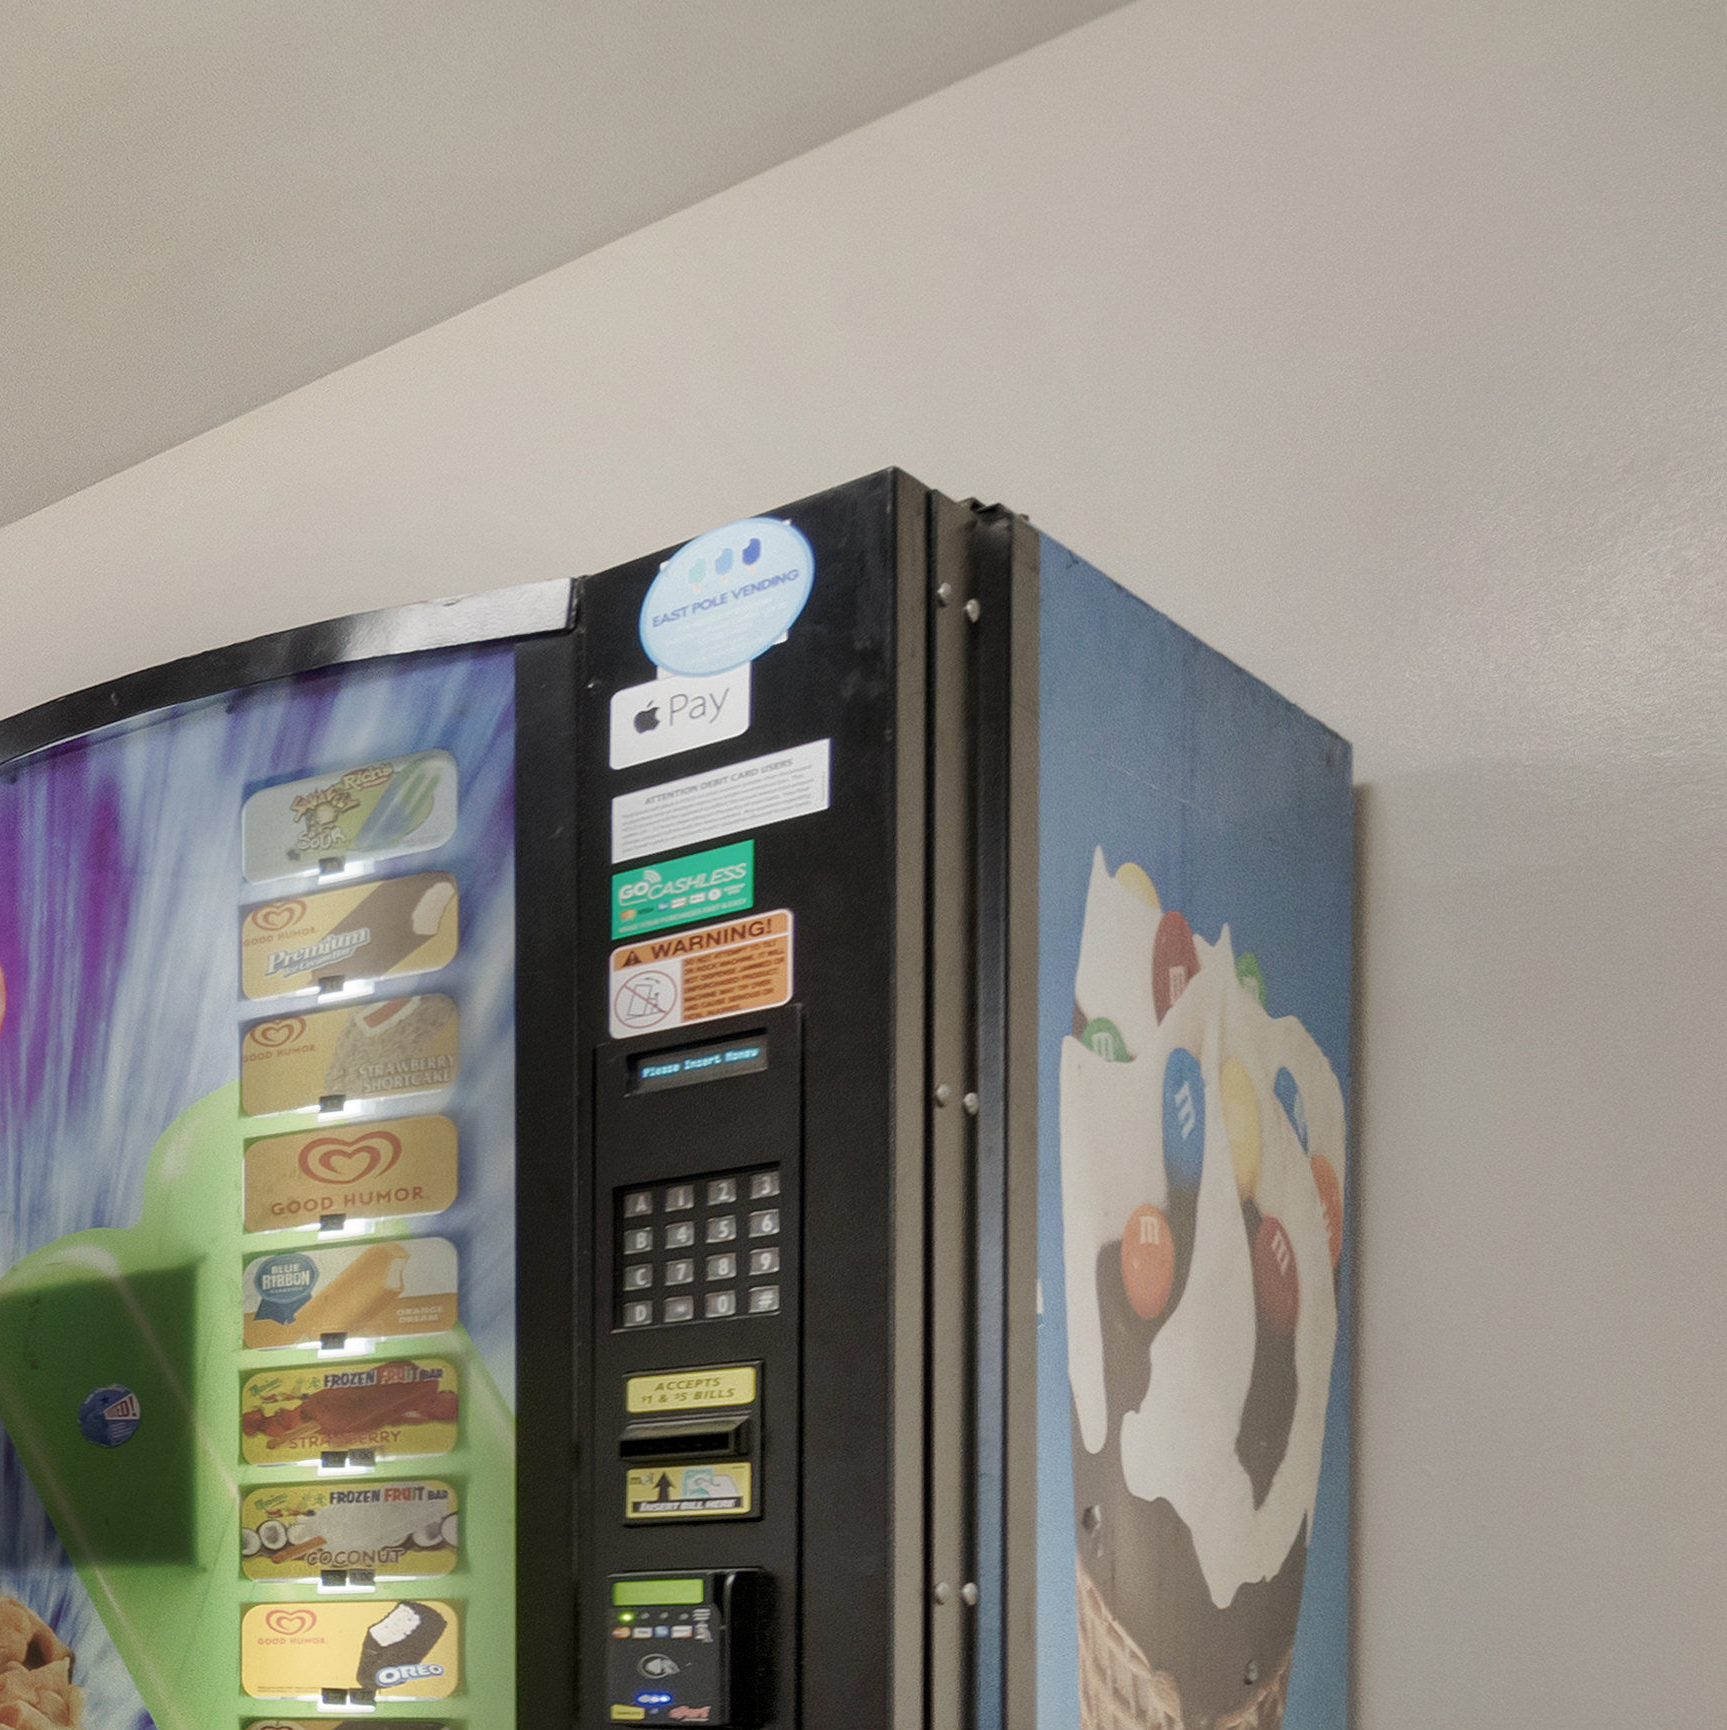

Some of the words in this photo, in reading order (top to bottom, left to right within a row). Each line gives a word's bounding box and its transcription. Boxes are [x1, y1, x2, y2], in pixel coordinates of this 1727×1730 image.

[652, 606, 689, 628] EAST
[692, 592, 729, 616] POLE
[731, 569, 800, 600] VENDING
[668, 688, 730, 726] Pay
[645, 785, 699, 805] ATTENTION
[700, 776, 729, 791] DEBIT
[731, 768, 759, 783] CARD
[761, 758, 794, 774] USERS
[648, 862, 748, 900] CASHLESS
[243, 935, 274, 948] GOOD
[651, 918, 773, 960] WARNING!
[265, 928, 370, 977] Premium
[277, 1045, 316, 1058] HUMOR
[359, 1055, 455, 1078] STRAWBERRY
[642, 1062, 681, 1079] Please
[683, 1054, 722, 1071] Insert
[363, 1068, 451, 1093] SHORTCAKE
[718, 1182, 729, 1200] 2
[760, 1177, 771, 1195] 3
[271, 1197, 334, 1216] GOOD
[343, 1186, 424, 1207] HUMOR
[636, 1194, 646, 1212] A
[677, 1187, 685, 1206] 1
[719, 1220, 729, 1238] 5
[761, 1215, 772, 1232] 6
[636, 1232, 646, 1249] B
[676, 1226, 687, 1243] 4
[271, 1263, 301, 1274] BLUE
[718, 1258, 729, 1276] 8
[760, 1253, 771, 1271] 9
[262, 1270, 310, 1290] RIBBON
[635, 1268, 646, 1286] C
[675, 1264, 686, 1281] 7
[396, 1306, 444, 1316] ORANGE
[635, 1305, 646, 1322] D
[717, 1296, 728, 1313] 0
[324, 1370, 376, 1388] FROZEN
[379, 1366, 420, 1385] FRUIT
[422, 1369, 444, 1380] BAR
[654, 1376, 721, 1392] ACCEPTS
[658, 1391, 668, 1403] &
[673, 1391, 689, 1403] $5
[693, 1387, 735, 1400] BILLS
[329, 1489, 381, 1504] FROZEN
[384, 1487, 426, 1501] FRUIT
[428, 1489, 449, 1500] BAR
[638, 1502, 679, 1512] INSERT
[679, 1501, 704, 1510] BILL
[705, 1499, 737, 1509] HERE
[306, 1549, 403, 1567] COCONUT
[377, 1663, 444, 1685] OREO
